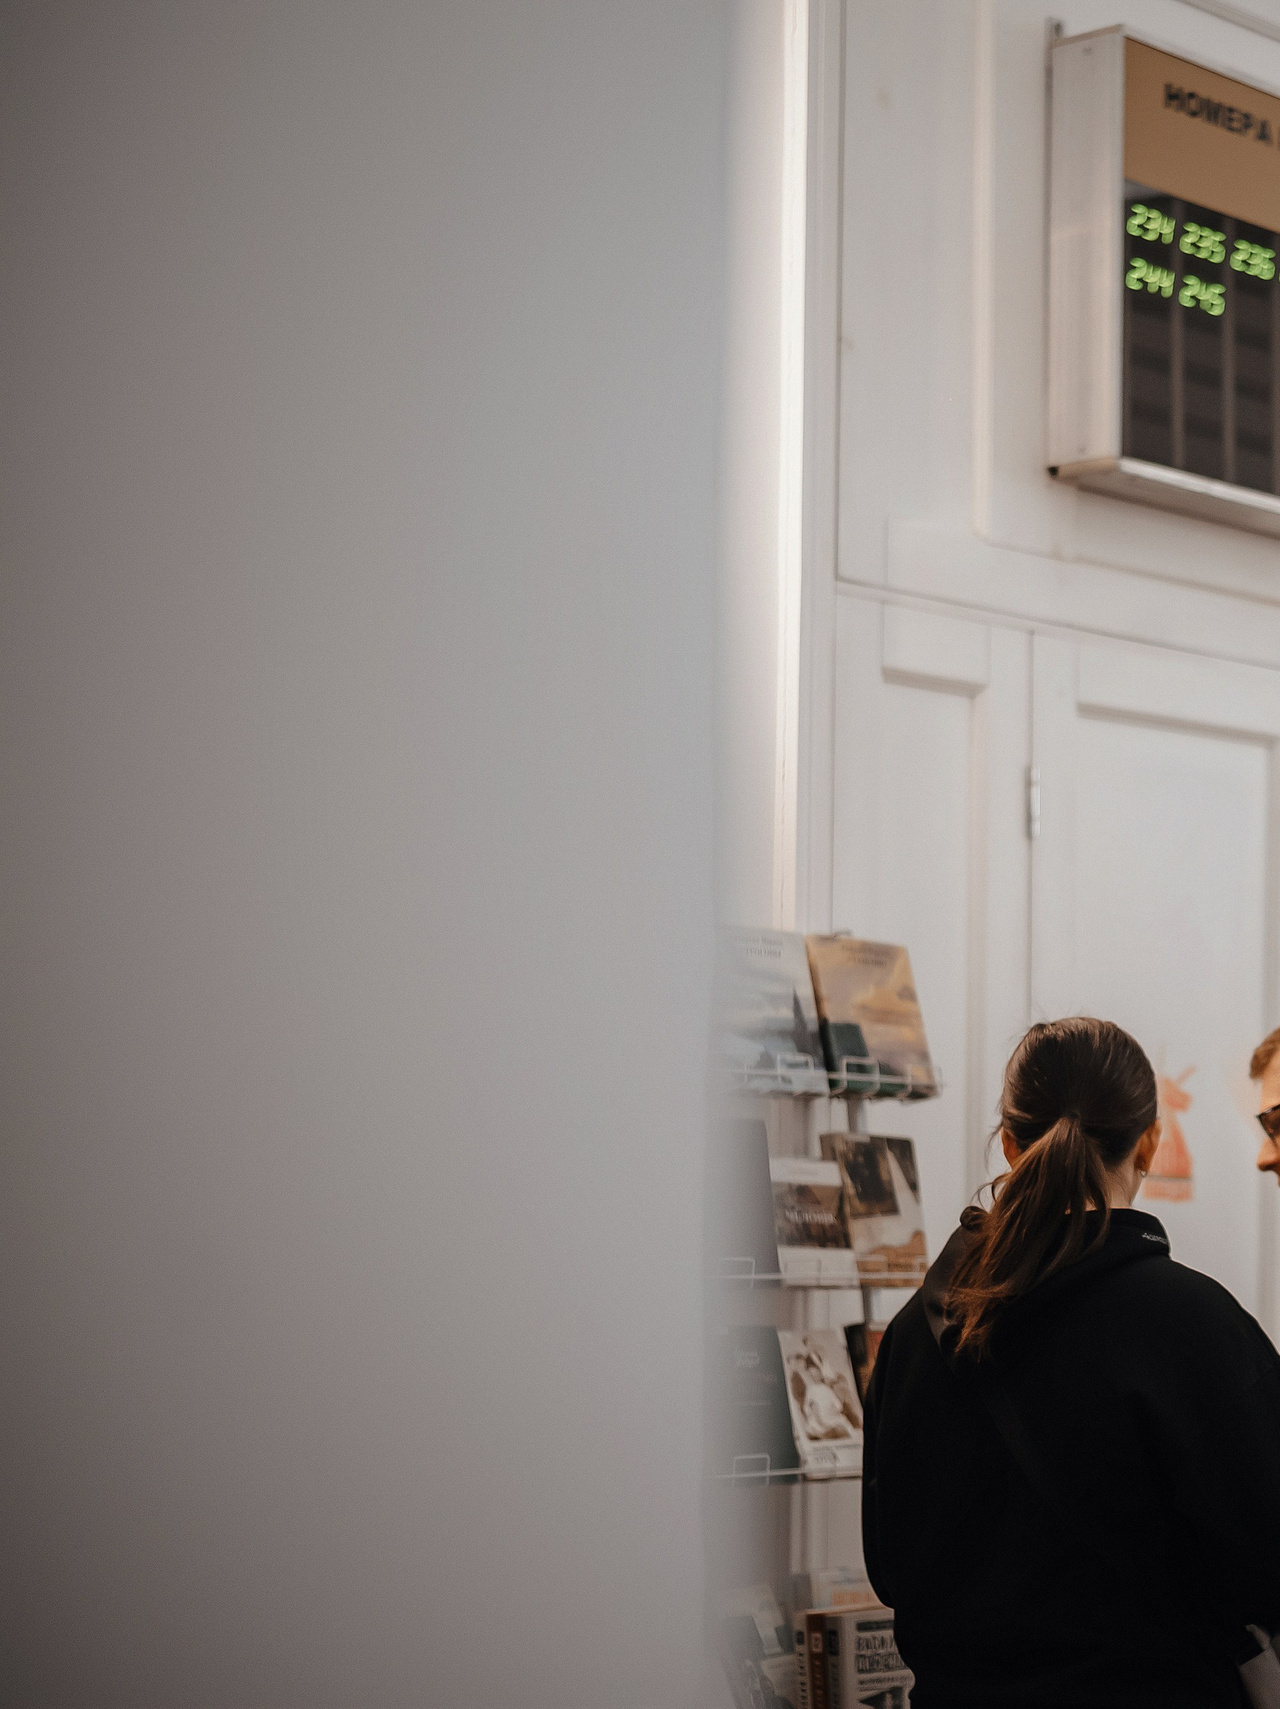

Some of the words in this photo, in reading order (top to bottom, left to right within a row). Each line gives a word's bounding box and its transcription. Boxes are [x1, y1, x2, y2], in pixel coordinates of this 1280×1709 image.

[1164, 82, 1271, 142] НОМЕРА
[1126, 204, 1176, 244] 234
[1179, 222, 1227, 264] 235
[1230, 239, 1276, 281] 236
[1125, 257, 1175, 298] 244
[1178, 274, 1226, 317] 245
